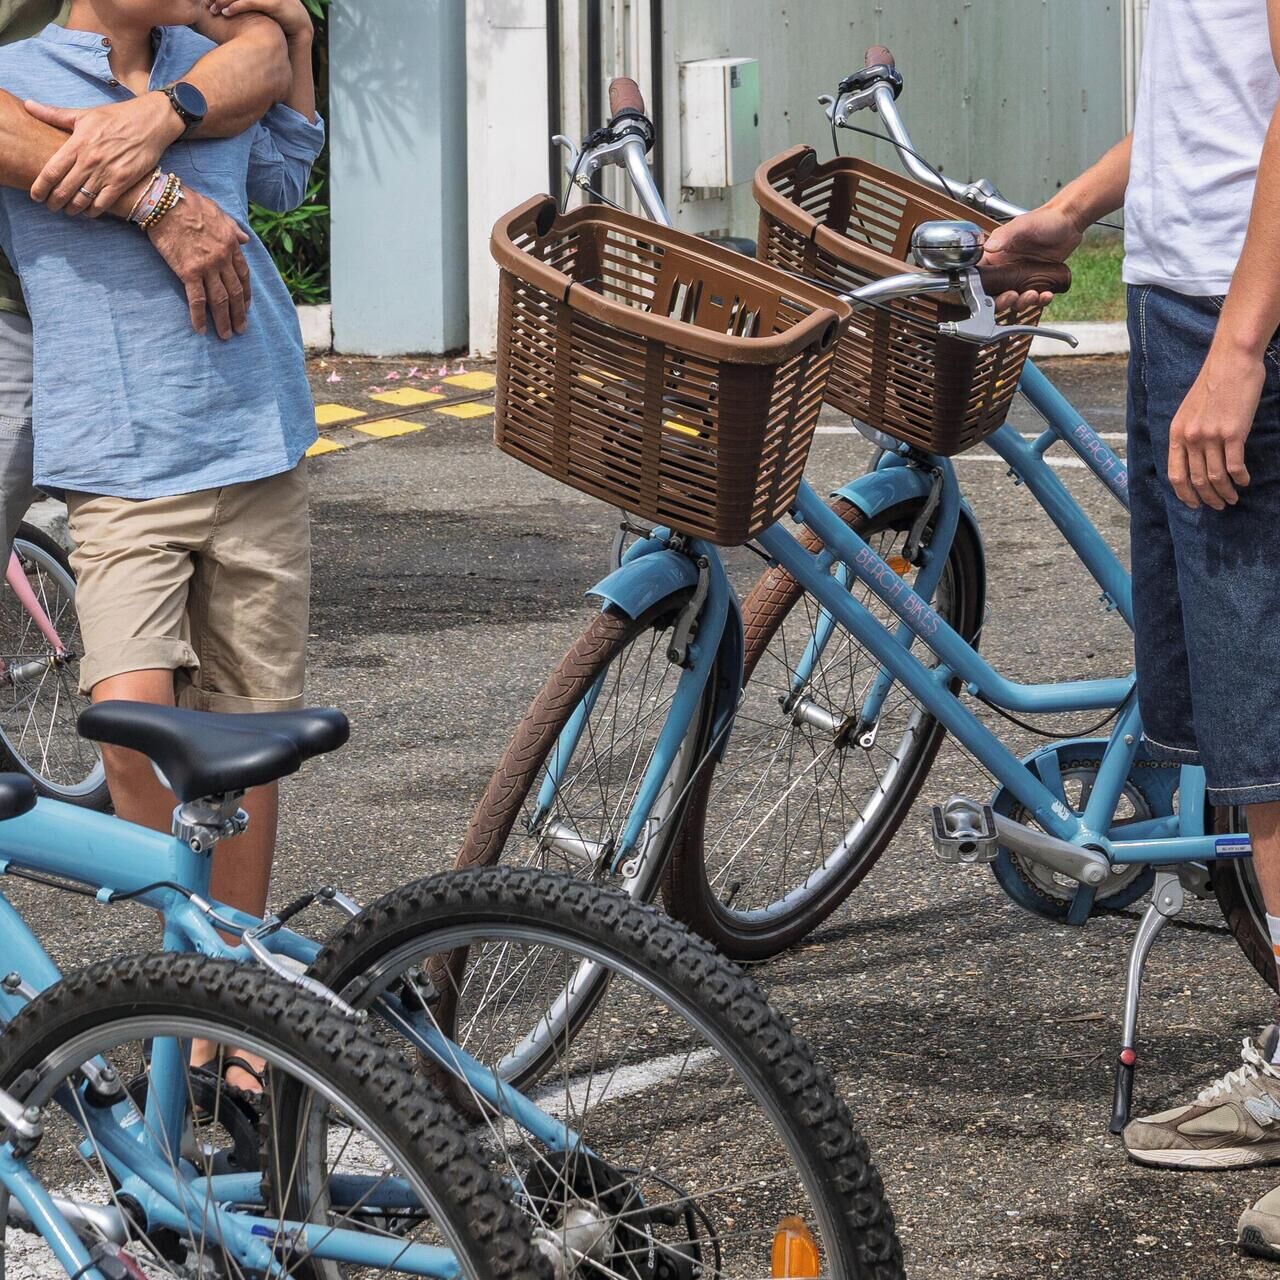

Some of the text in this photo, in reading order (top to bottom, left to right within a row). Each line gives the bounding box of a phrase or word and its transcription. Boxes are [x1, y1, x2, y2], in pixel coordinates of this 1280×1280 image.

[1073, 424, 1117, 472] BEACH
[855, 547, 941, 634] BEACH BIKES
